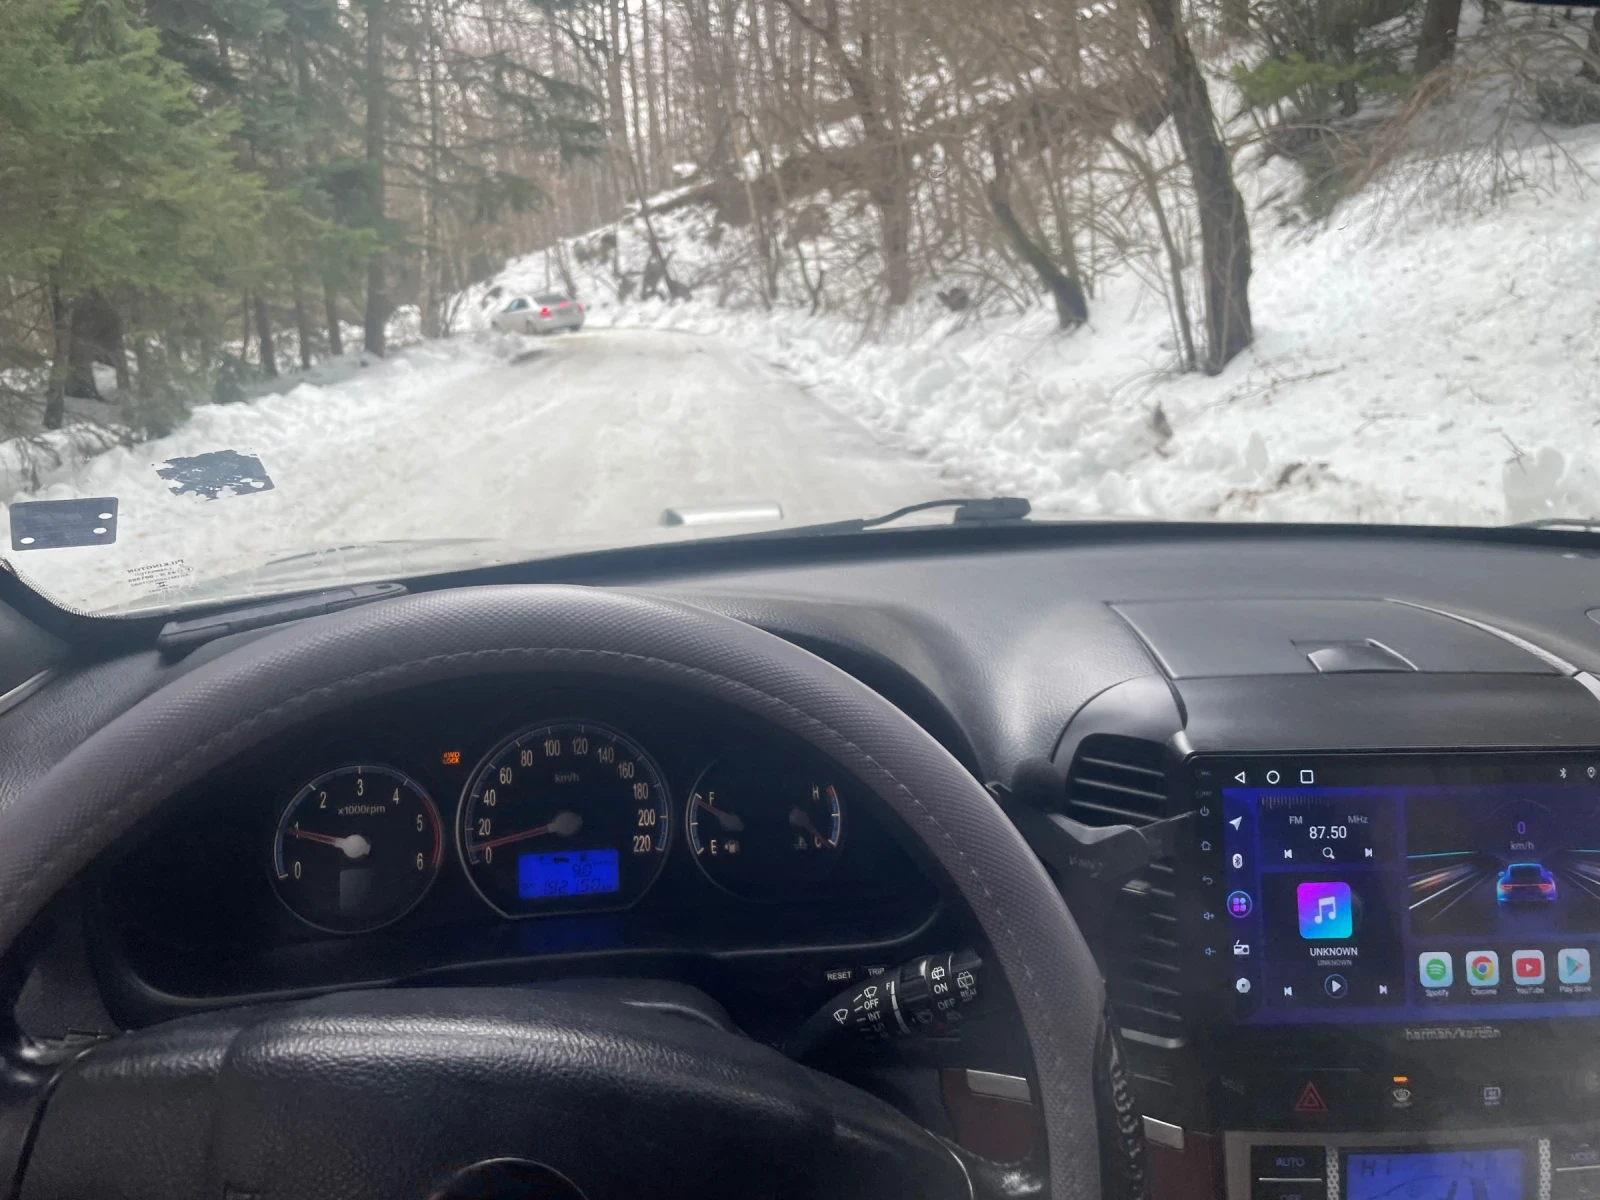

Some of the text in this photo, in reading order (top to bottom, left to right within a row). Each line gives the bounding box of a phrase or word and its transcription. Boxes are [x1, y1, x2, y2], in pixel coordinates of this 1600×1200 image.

[544, 739, 560, 756] 100
[572, 738, 588, 755] 120
[442, 757, 460, 765] LOCK
[521, 750, 533, 767] 80
[598, 747, 614, 764] 140
[500, 767, 512, 784] 60
[554, 772, 580, 783] km/h
[618, 762, 634, 779] 160
[357, 779, 364, 796] 3
[633, 783, 649, 799] 180
[812, 785, 819, 800] H
[320, 791, 327, 808] 2
[392, 788, 399, 804] 4
[483, 789, 496, 806] 40
[709, 791, 715, 805] F
[338, 804, 386, 816] x1000rpm
[638, 809, 656, 826] 200
[416, 814, 423, 832] 5
[479, 818, 491, 836] 20
[1289, 815, 1303, 825] FM
[1347, 815, 1368, 824] MHz
[294, 821, 300, 839] 1
[1309, 826, 1347, 839] 87.50
[1517, 821, 1526, 835] 0
[633, 835, 651, 852] 220
[710, 839, 717, 854] E
[1510, 841, 1534, 851] km/h
[416, 853, 423, 870] 6
[485, 847, 492, 864] 0
[294, 861, 301, 879] 0
[1309, 947, 1358, 956] UNKNOWN
[826, 970, 852, 981] RESET
[868, 967, 885, 976] TRIP
[933, 983, 948, 995] ON
[1425, 989, 1449, 998] Spotify
[1471, 988, 1497, 996] Chrome
[863, 998, 879, 1010] OFF
[937, 998, 956, 1011] OFF
[867, 1011, 881, 1022] INT
[1275, 1157, 1305, 1167] AUTO
